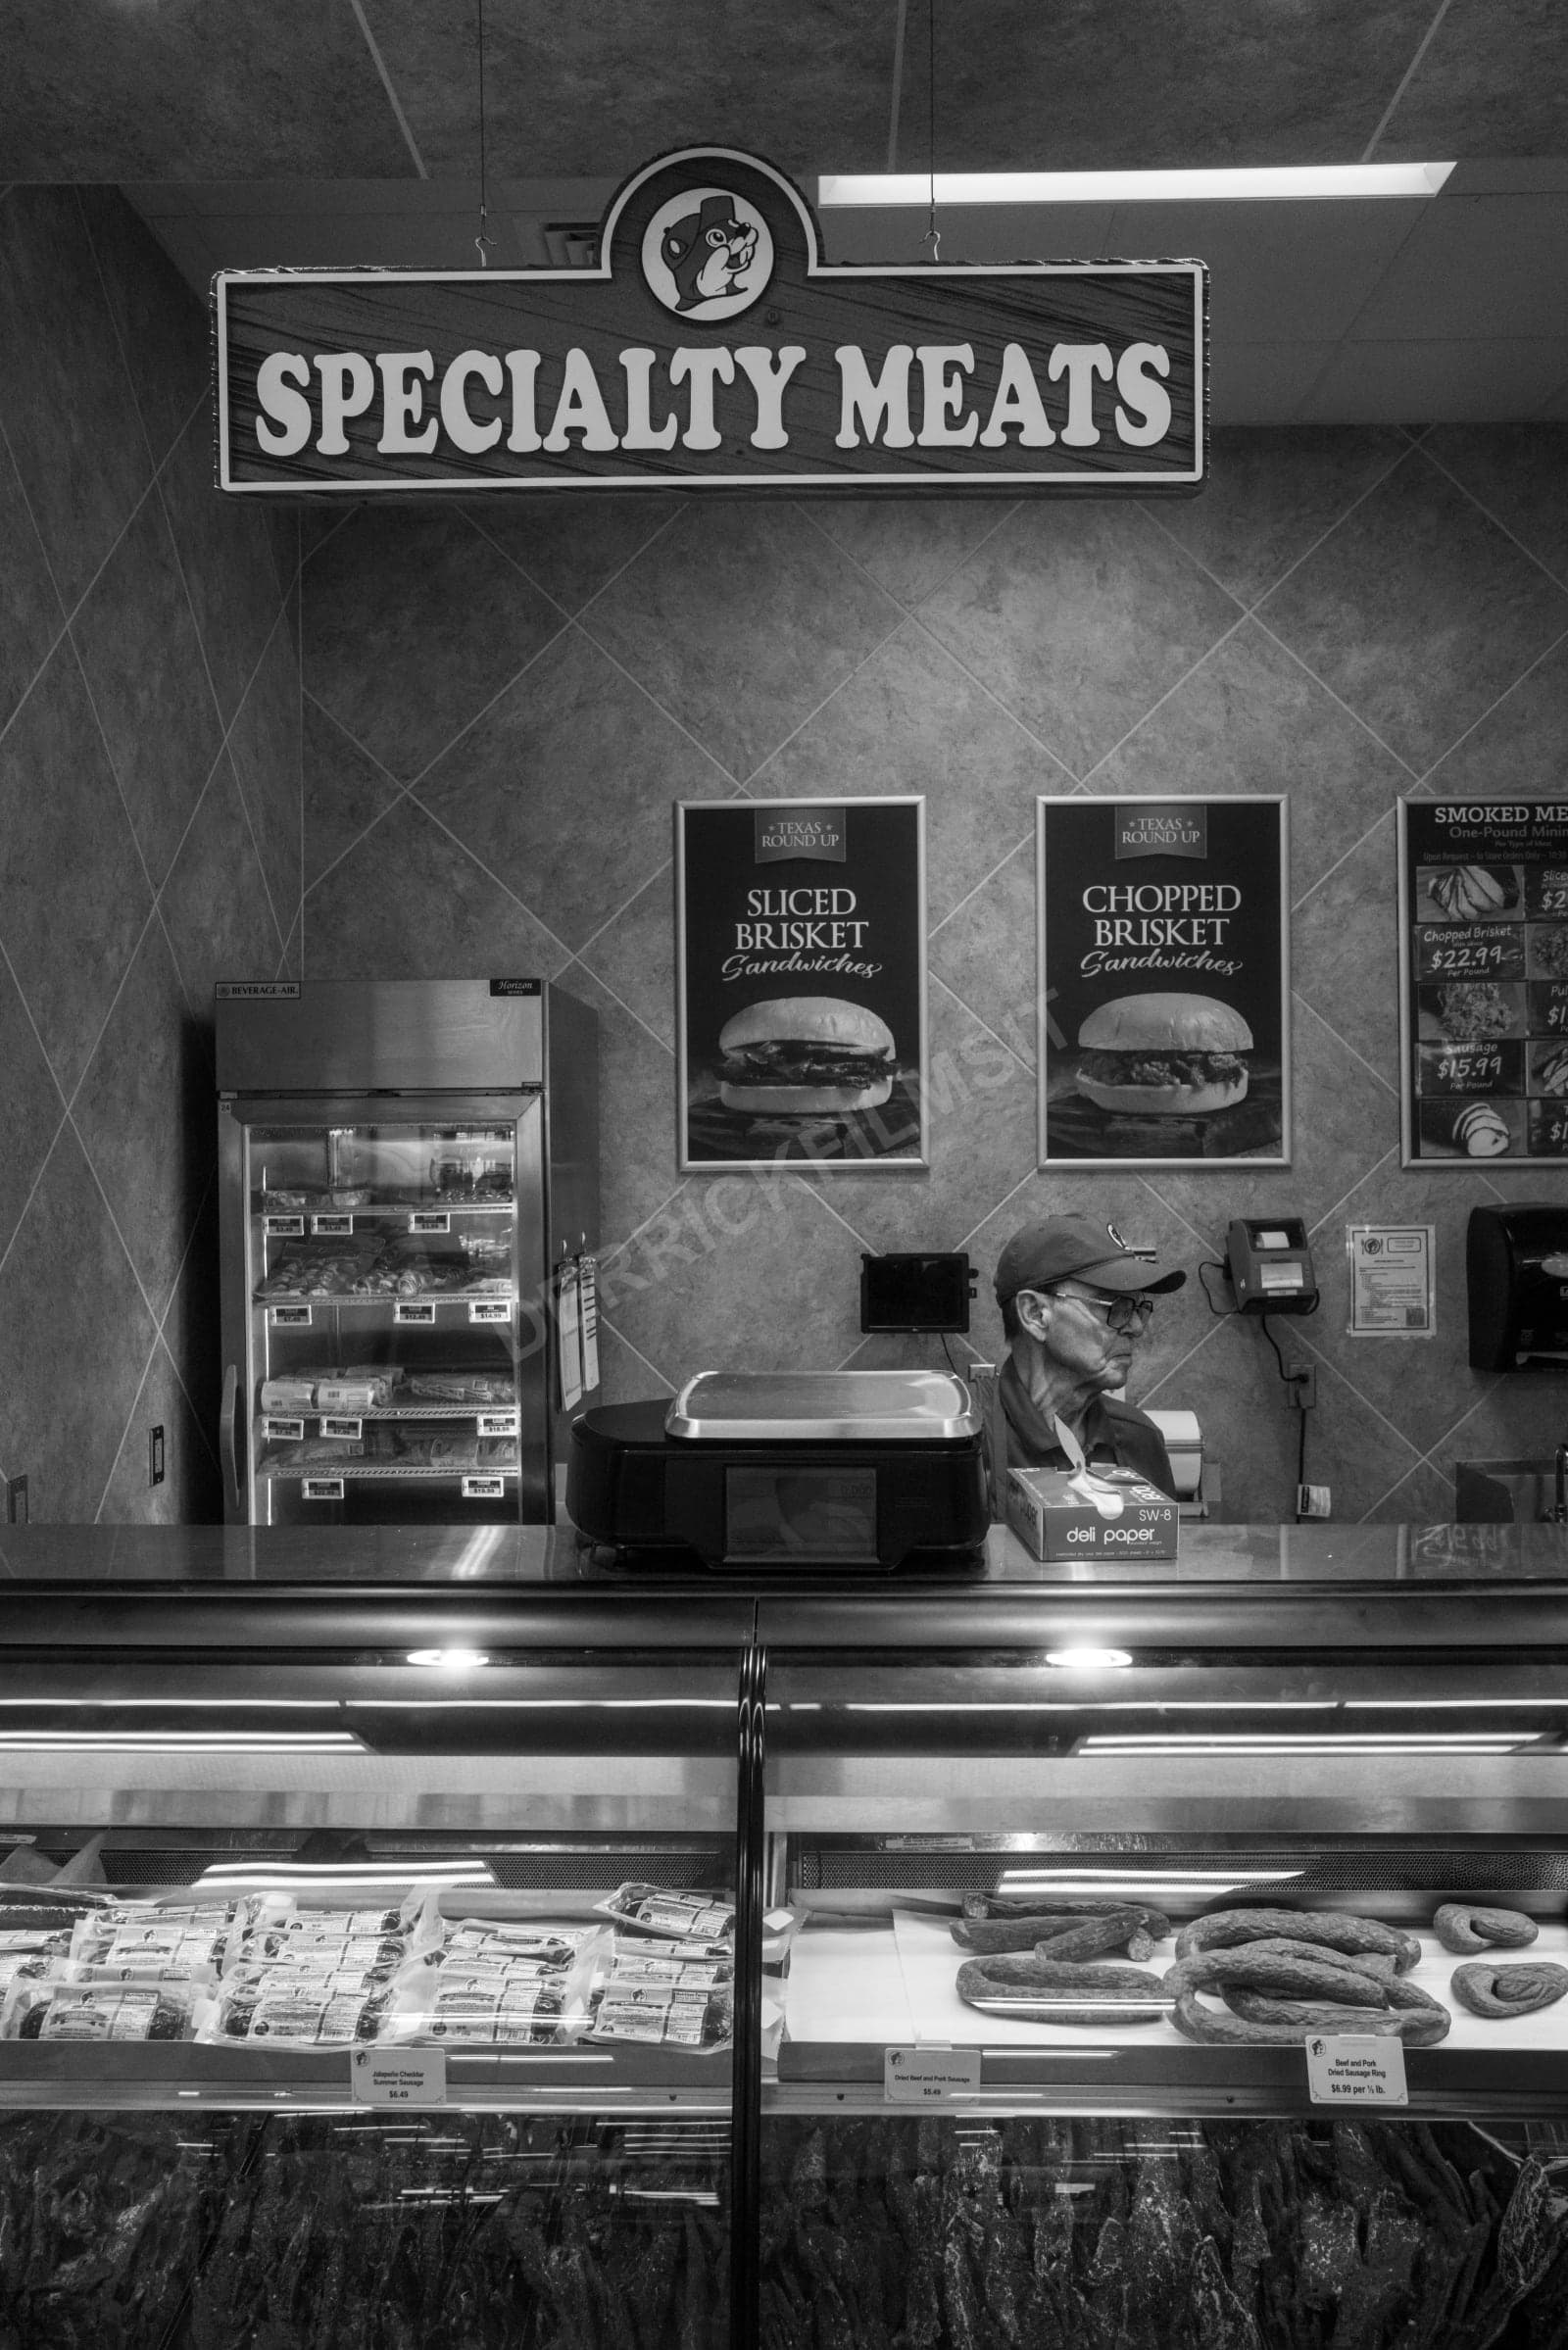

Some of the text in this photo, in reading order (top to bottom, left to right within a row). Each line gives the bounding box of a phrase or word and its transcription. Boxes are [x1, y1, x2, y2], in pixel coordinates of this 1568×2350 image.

[255, 341, 1172, 457] SPECIALTY MEATS
[1435, 807, 1530, 823] SMOKED
[777, 820, 823, 835] TEXAS
[1137, 817, 1183, 832] TEXAS
[1449, 825, 1528, 839] One-Pound
[761, 834, 840, 849] ROUND UP
[1121, 830, 1201, 845] ROUND UP
[1543, 869, 1568, 882] Slice
[746, 888, 858, 918] SLICED
[1082, 884, 1243, 914] CHOPPED
[734, 919, 869, 952] BRISKET
[1094, 917, 1230, 948] BRISKET
[1424, 924, 1512, 943] Chopped Brisket
[1080, 949, 1244, 978] Sandwiches
[1431, 945, 1502, 970] $22.99
[721, 952, 883, 982] Sandwiches
[498, 980, 533, 990] Horizon
[1445, 1043, 1498, 1055] Sausage
[1437, 1055, 1502, 1080] $15.99
[1138, 1508, 1172, 1522] SW-8
[1066, 1526, 1155, 1545] deli paper
[1335, 2058, 1349, 2067] Beef
[1328, 2068, 1387, 2079] Dried Sausage Ring
[1331, 2083, 1351, 2094] $6.99
[1353, 2085, 1366, 2095] per
